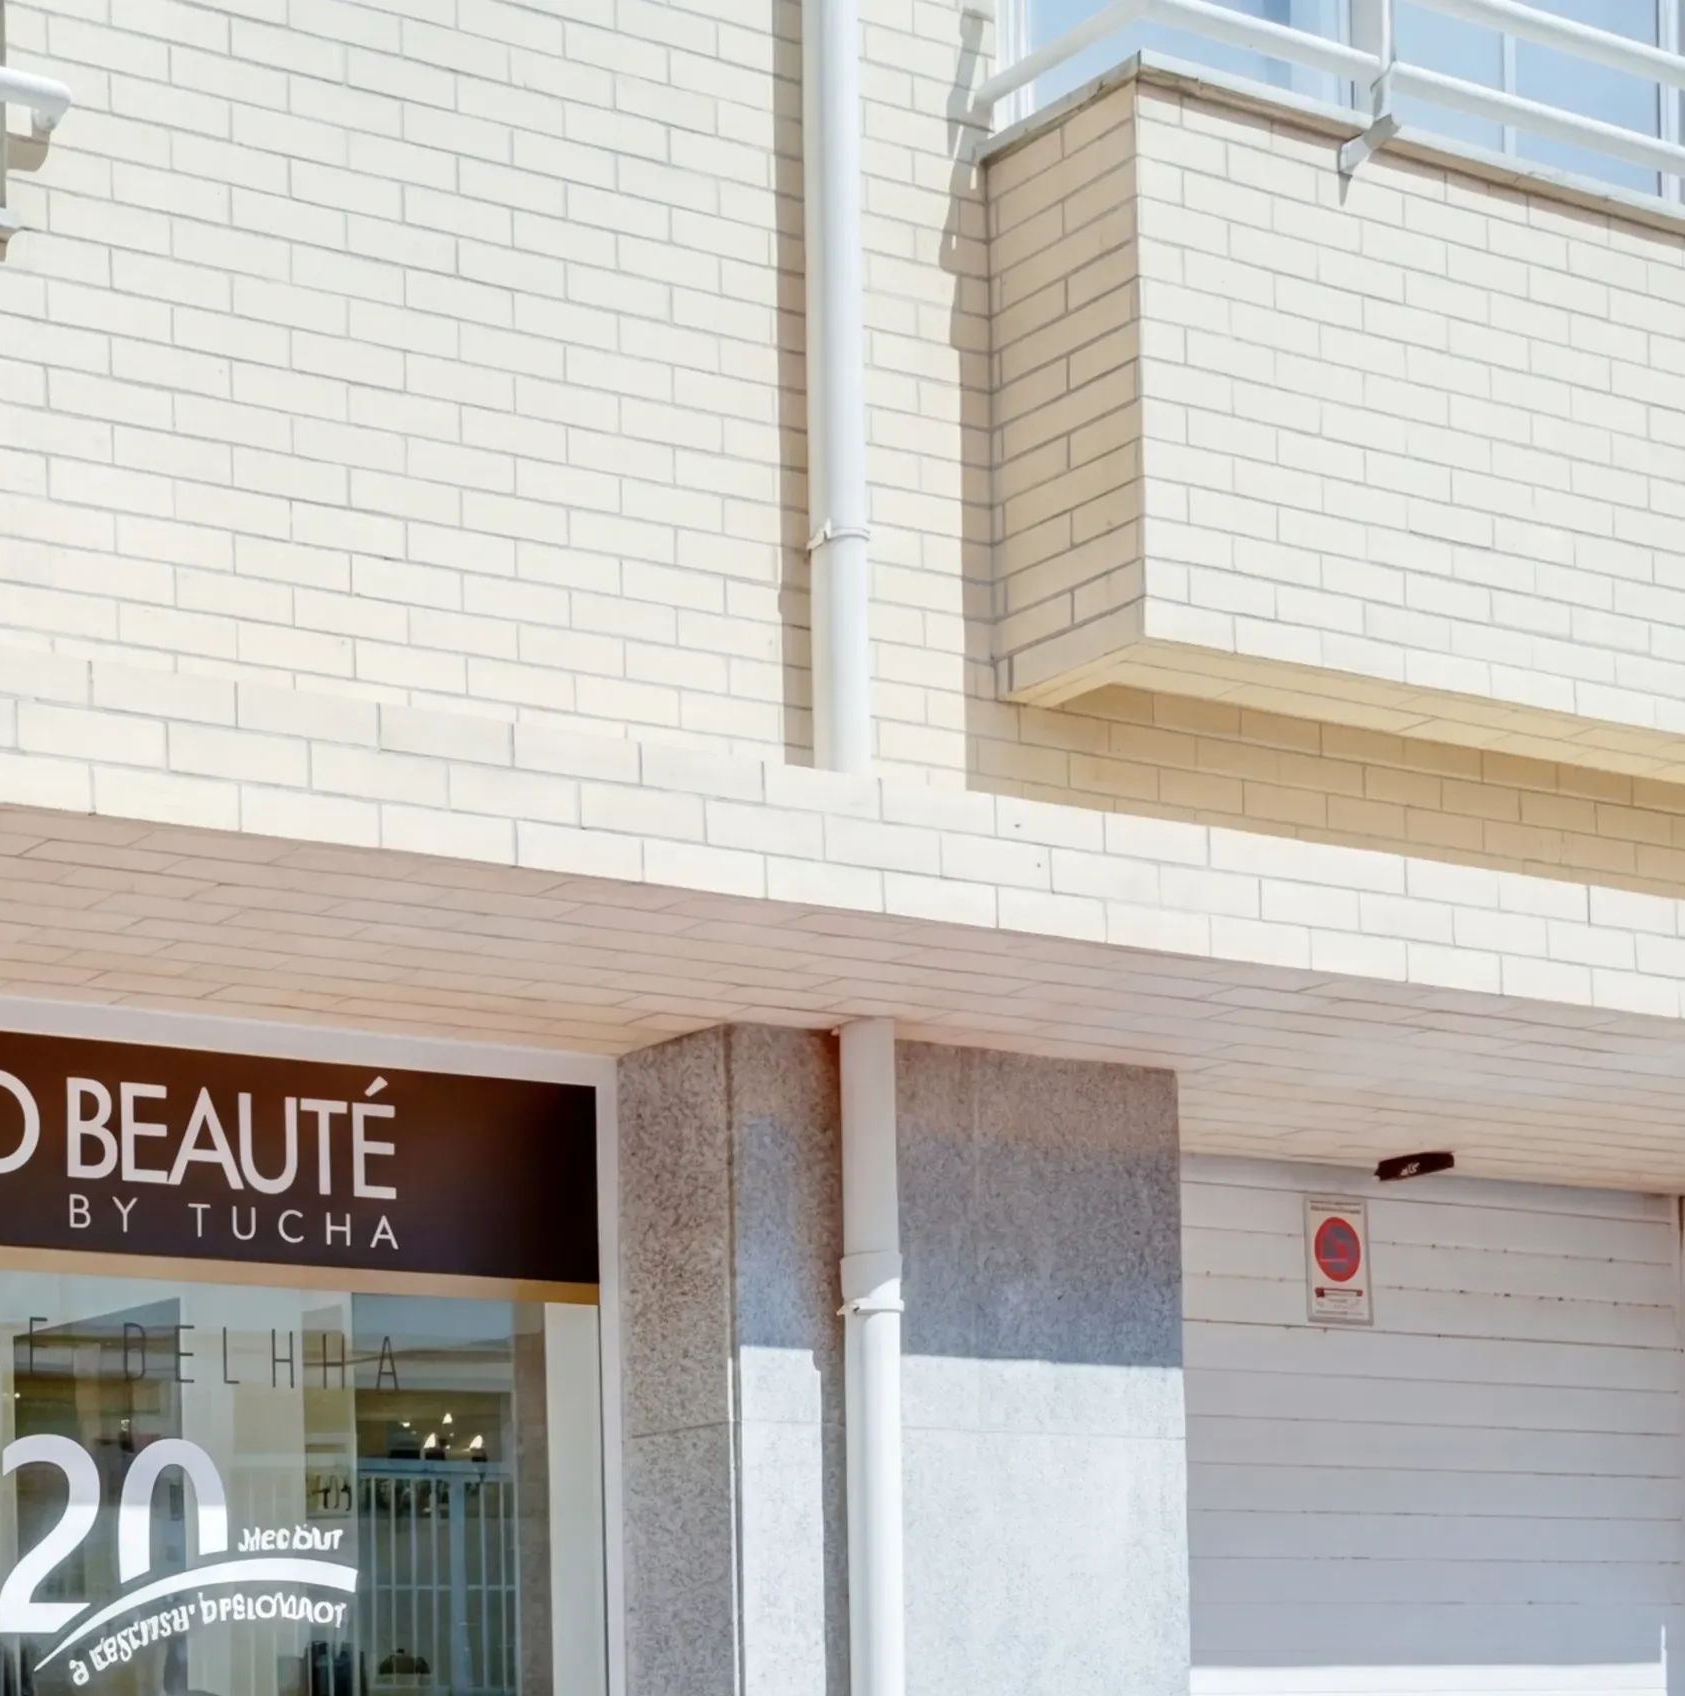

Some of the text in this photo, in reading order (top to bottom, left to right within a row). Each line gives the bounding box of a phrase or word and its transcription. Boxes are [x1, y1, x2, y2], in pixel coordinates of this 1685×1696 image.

[66, 1075, 397, 1200] BEAUTÉ
[69, 1193, 399, 1250] BY TUCHA
